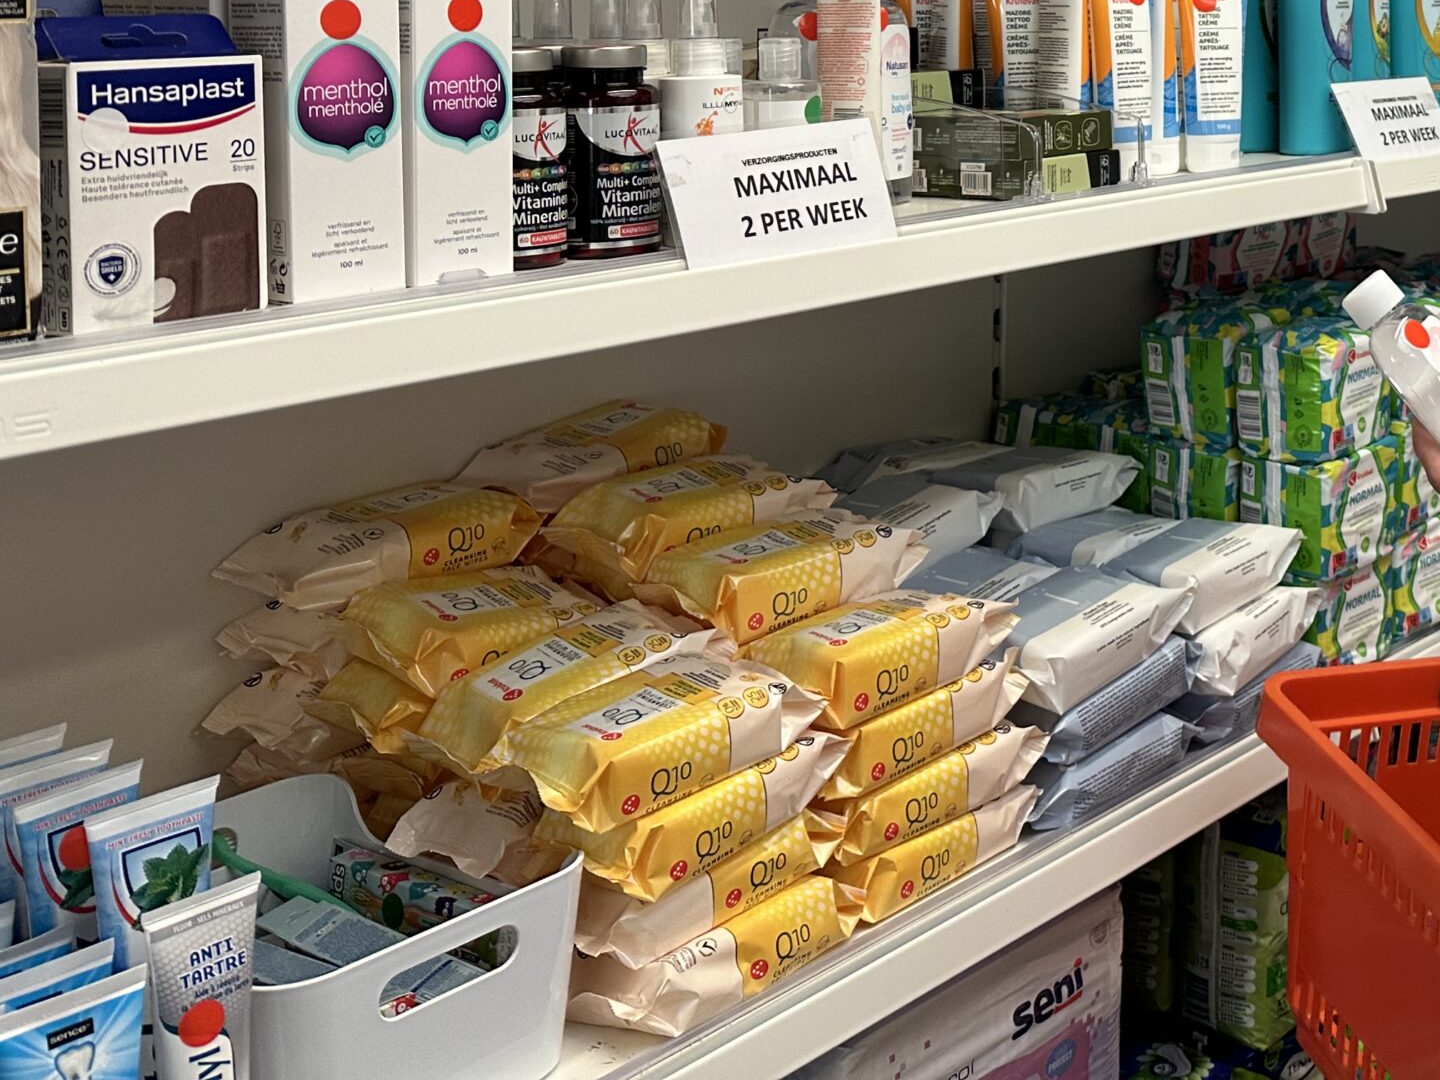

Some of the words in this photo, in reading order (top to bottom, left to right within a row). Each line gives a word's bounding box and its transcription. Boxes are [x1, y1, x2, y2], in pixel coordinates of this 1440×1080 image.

[1005, 9, 1032, 17] NAZORG
[1006, 16, 1031, 24] TATTOO
[1198, 18, 1218, 26] CRÈME
[1005, 22, 1028, 30] CRÈME
[1114, 21, 1132, 29] CRÈME
[1198, 30, 1220, 38] CRÈME
[1006, 33, 1029, 42] CRÈME
[1006, 40, 1031, 48] APRÈS-
[1114, 32, 1133, 41] CRÈME
[1115, 40, 1136, 48] APRÈS-
[1199, 37, 1221, 45] APRÈS-
[91, 77, 245, 107] Hansaplast
[303, 76, 388, 102] menthol
[428, 73, 501, 96] menthol
[308, 95, 384, 118] mentholé
[432, 90, 498, 111] mentholé
[1371, 102, 1429, 122] MAXIMAAL
[1380, 132, 1390, 146] 2
[1389, 129, 1411, 145] PER
[1408, 125, 1440, 142] WEEK
[80, 142, 208, 171] SENSITIVE
[230, 138, 255, 159] 20
[741, 147, 838, 167] VERZORGINGSPRODUCTEN
[81, 176, 105, 185] Extra
[107, 171, 168, 183] huidvriendelijk
[232, 163, 255, 172] Strips
[81, 184, 107, 194] Haute
[597, 176, 630, 189] Multi+
[733, 161, 858, 199] MAXIMAAL
[81, 193, 128, 203] Besonders
[601, 187, 661, 204] Vitaminen
[602, 201, 661, 219] Mineralen
[741, 216, 757, 238] 2
[762, 208, 801, 235] PER
[805, 197, 868, 229] WEEK
[519, 236, 529, 244] 60
[609, 227, 619, 236] 60
[339, 260, 354, 269] 100
[354, 259, 364, 268] ml
[1347, 366, 1381, 385] NORMAL
[655, 440, 683, 468] Q10
[1349, 483, 1384, 506] NORMAL
[448, 523, 485, 555] Q10
[444, 550, 488, 567] CLEANSING
[772, 588, 808, 621] Q10
[1345, 587, 1382, 612] NORMAL
[768, 613, 809, 633] CLEANSING
[508, 658, 552, 681] Q10
[876, 664, 909, 700] Q10
[873, 691, 910, 714] CLEANSING
[602, 707, 649, 725] Q10
[892, 731, 924, 768] Q10
[889, 757, 926, 780] CLEANSING
[651, 761, 692, 802] Q10
[645, 789, 694, 814] CLEANSING
[905, 791, 938, 829] Q10
[157, 812, 205, 834] TOOTHPASTE
[902, 817, 940, 840] CLEANSING
[696, 821, 733, 864] Q10
[692, 847, 734, 877] CLEANSING
[750, 852, 787, 893] Q10
[921, 849, 950, 886] Q10
[916, 875, 951, 897] CLEANSING
[189, 936, 234, 967] ANTI
[776, 923, 811, 966] Q10
[179, 949, 248, 990] TARTRE
[1011, 956, 1084, 1041] seni
